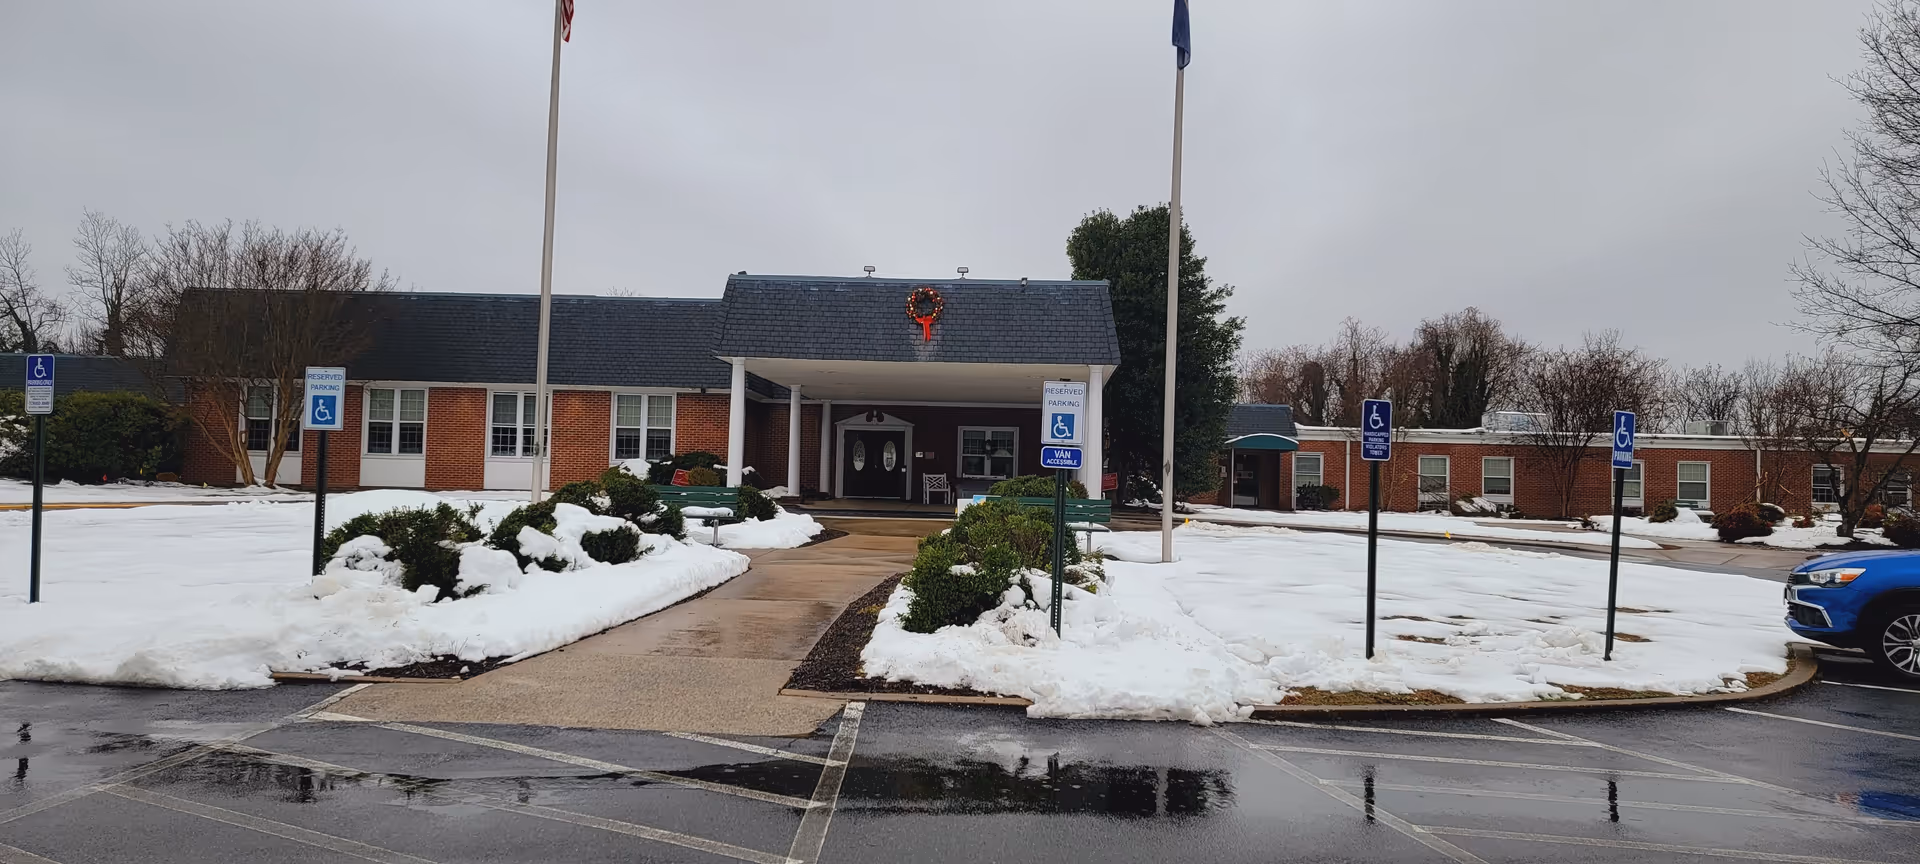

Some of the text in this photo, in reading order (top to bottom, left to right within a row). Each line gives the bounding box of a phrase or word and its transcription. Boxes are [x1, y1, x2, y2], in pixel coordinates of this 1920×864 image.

[307, 373, 343, 381] RESERVED
[1045, 387, 1084, 396] RESERVED
[1048, 399, 1080, 407] PARKING
[1054, 449, 1071, 459] VAN
[1614, 450, 1632, 463] PARKING
[1046, 458, 1078, 466] ACCESSIBLE
